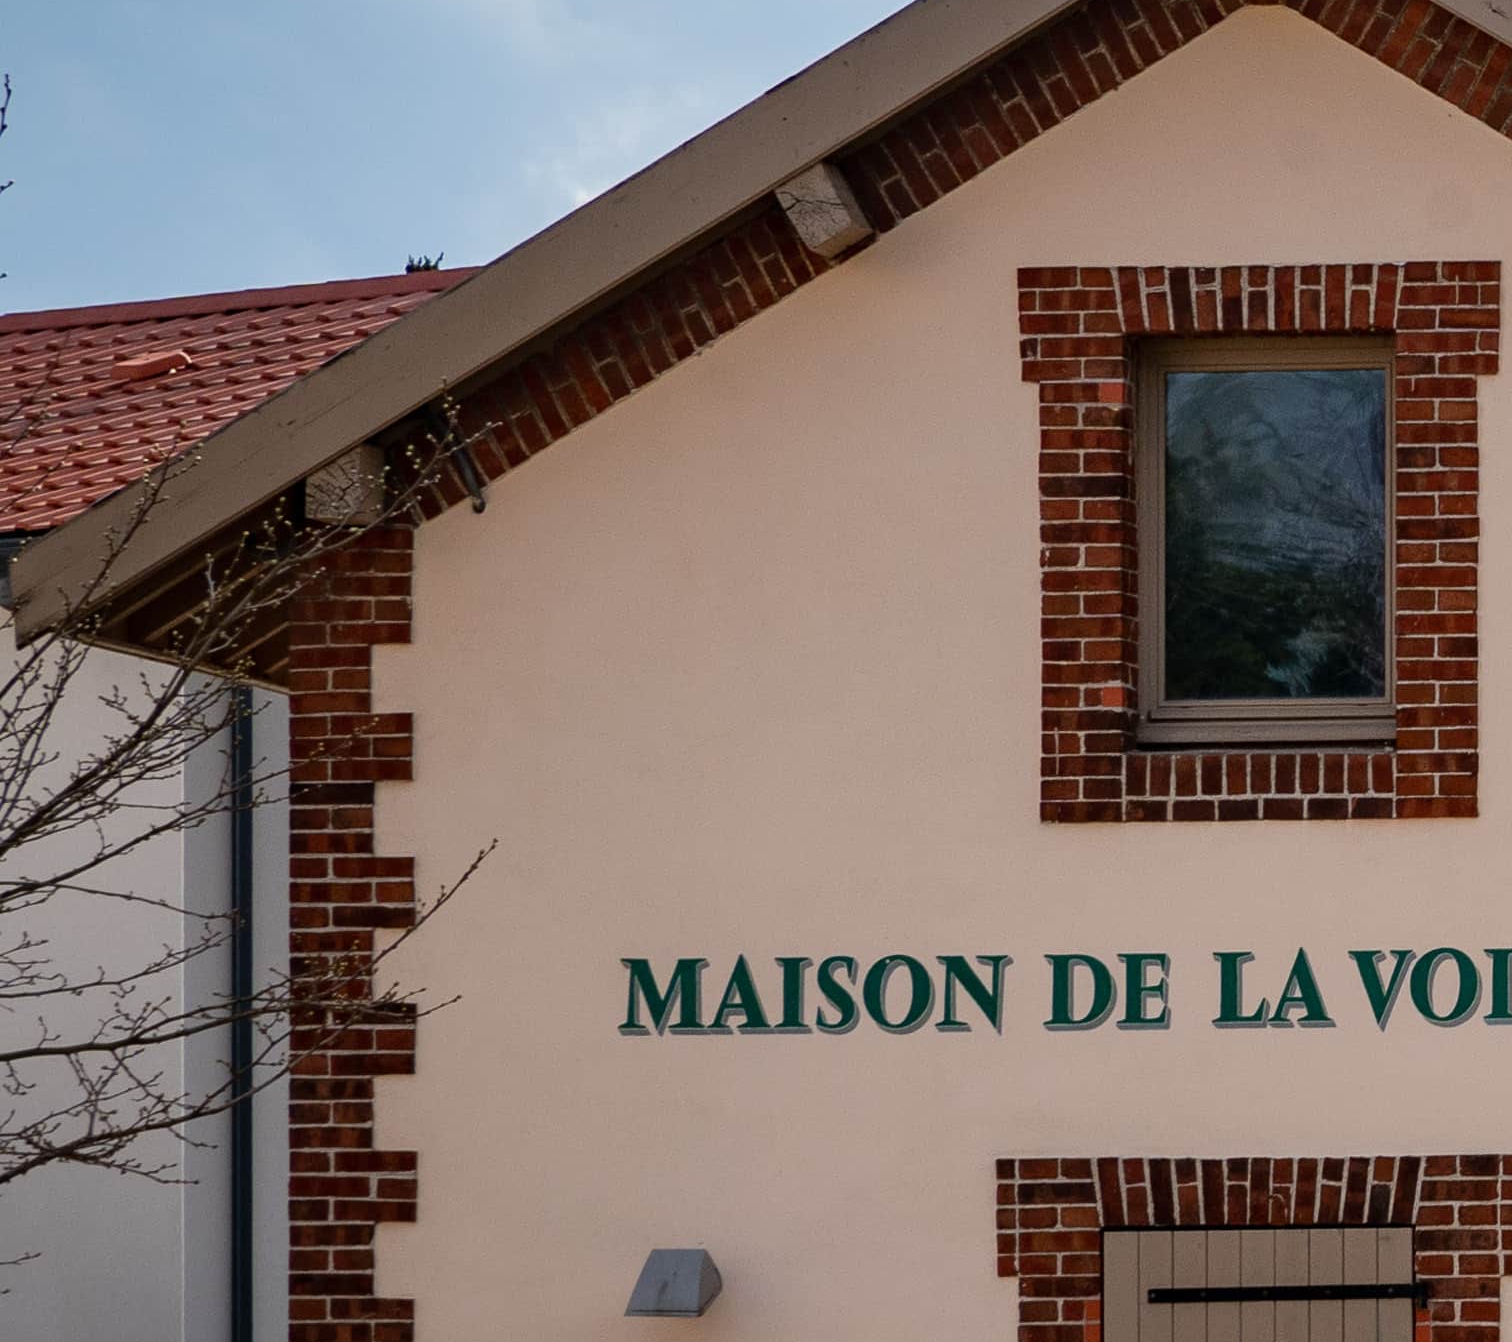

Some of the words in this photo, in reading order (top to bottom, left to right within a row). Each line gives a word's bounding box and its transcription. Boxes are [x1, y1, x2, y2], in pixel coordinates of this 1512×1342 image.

[617, 954, 1013, 1036] MAISON
[1042, 952, 1172, 1031] DE
[1211, 948, 1336, 1028] LA
